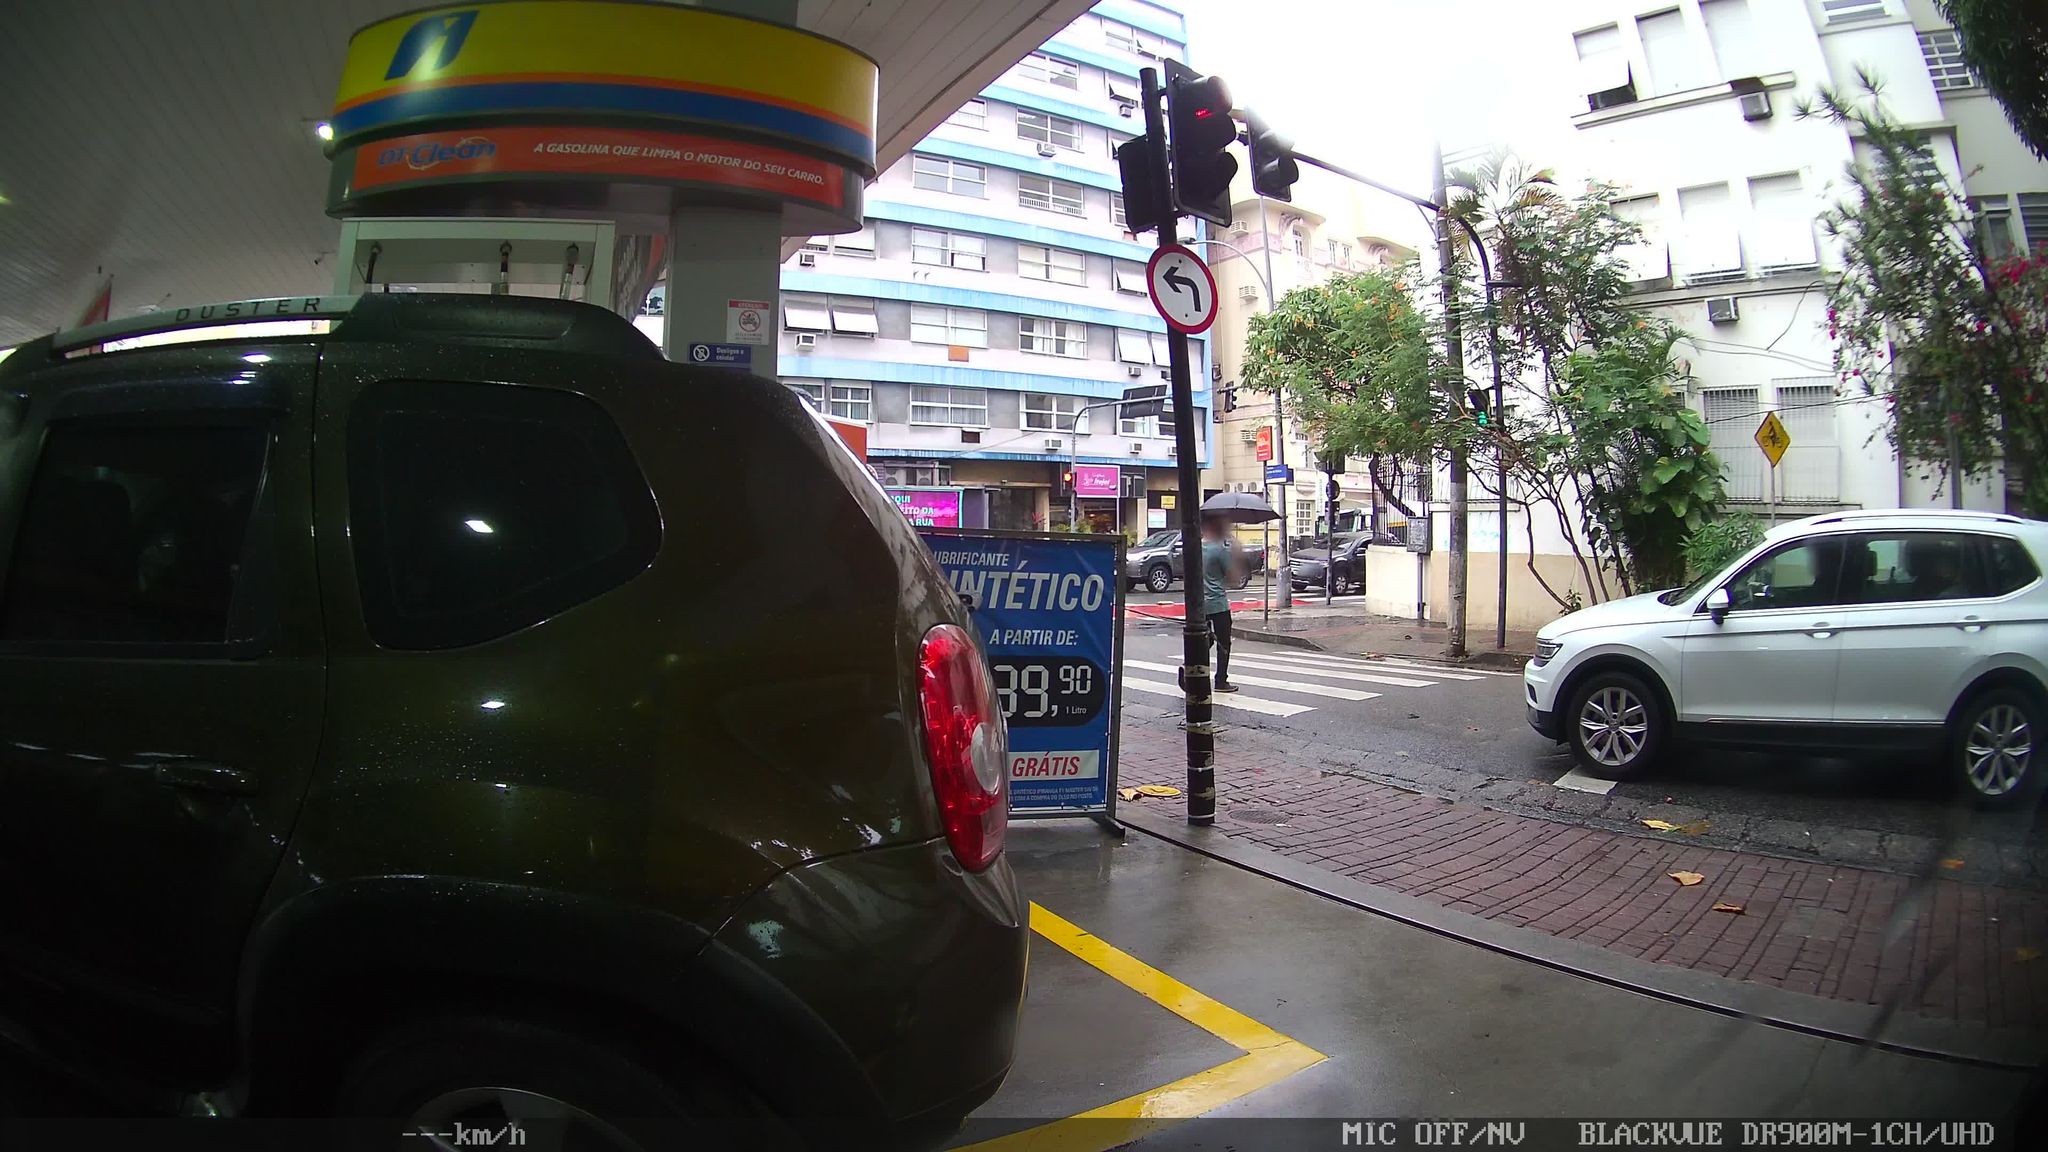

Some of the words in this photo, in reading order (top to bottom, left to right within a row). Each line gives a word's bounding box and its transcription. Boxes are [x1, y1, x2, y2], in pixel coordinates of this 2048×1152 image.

[534, 143, 543, 153] A
[546, 143, 609, 155] GASOLINA
[612, 145, 640, 156] QUE
[641, 147, 681, 160] LIMPA
[684, 151, 694, 161] O
[697, 152, 741, 167] MOTOR
[743, 159, 761, 170] DO
[763, 163, 786, 175] SEU
[787, 168, 825, 185] CARRO.
[175, 297, 321, 322] DUSTER
[934, 551, 1010, 567] UBRIFICANTE
[950, 560, 1105, 612] INTÉTICO
[989, 629, 1000, 645] A
[1003, 629, 1053, 646] PARTIR
[1056, 630, 1079, 646] DE:
[1059, 665, 1092, 694] 90
[1071, 706, 1087, 714] Litro
[1012, 751, 1080, 777] GRÁTIS
